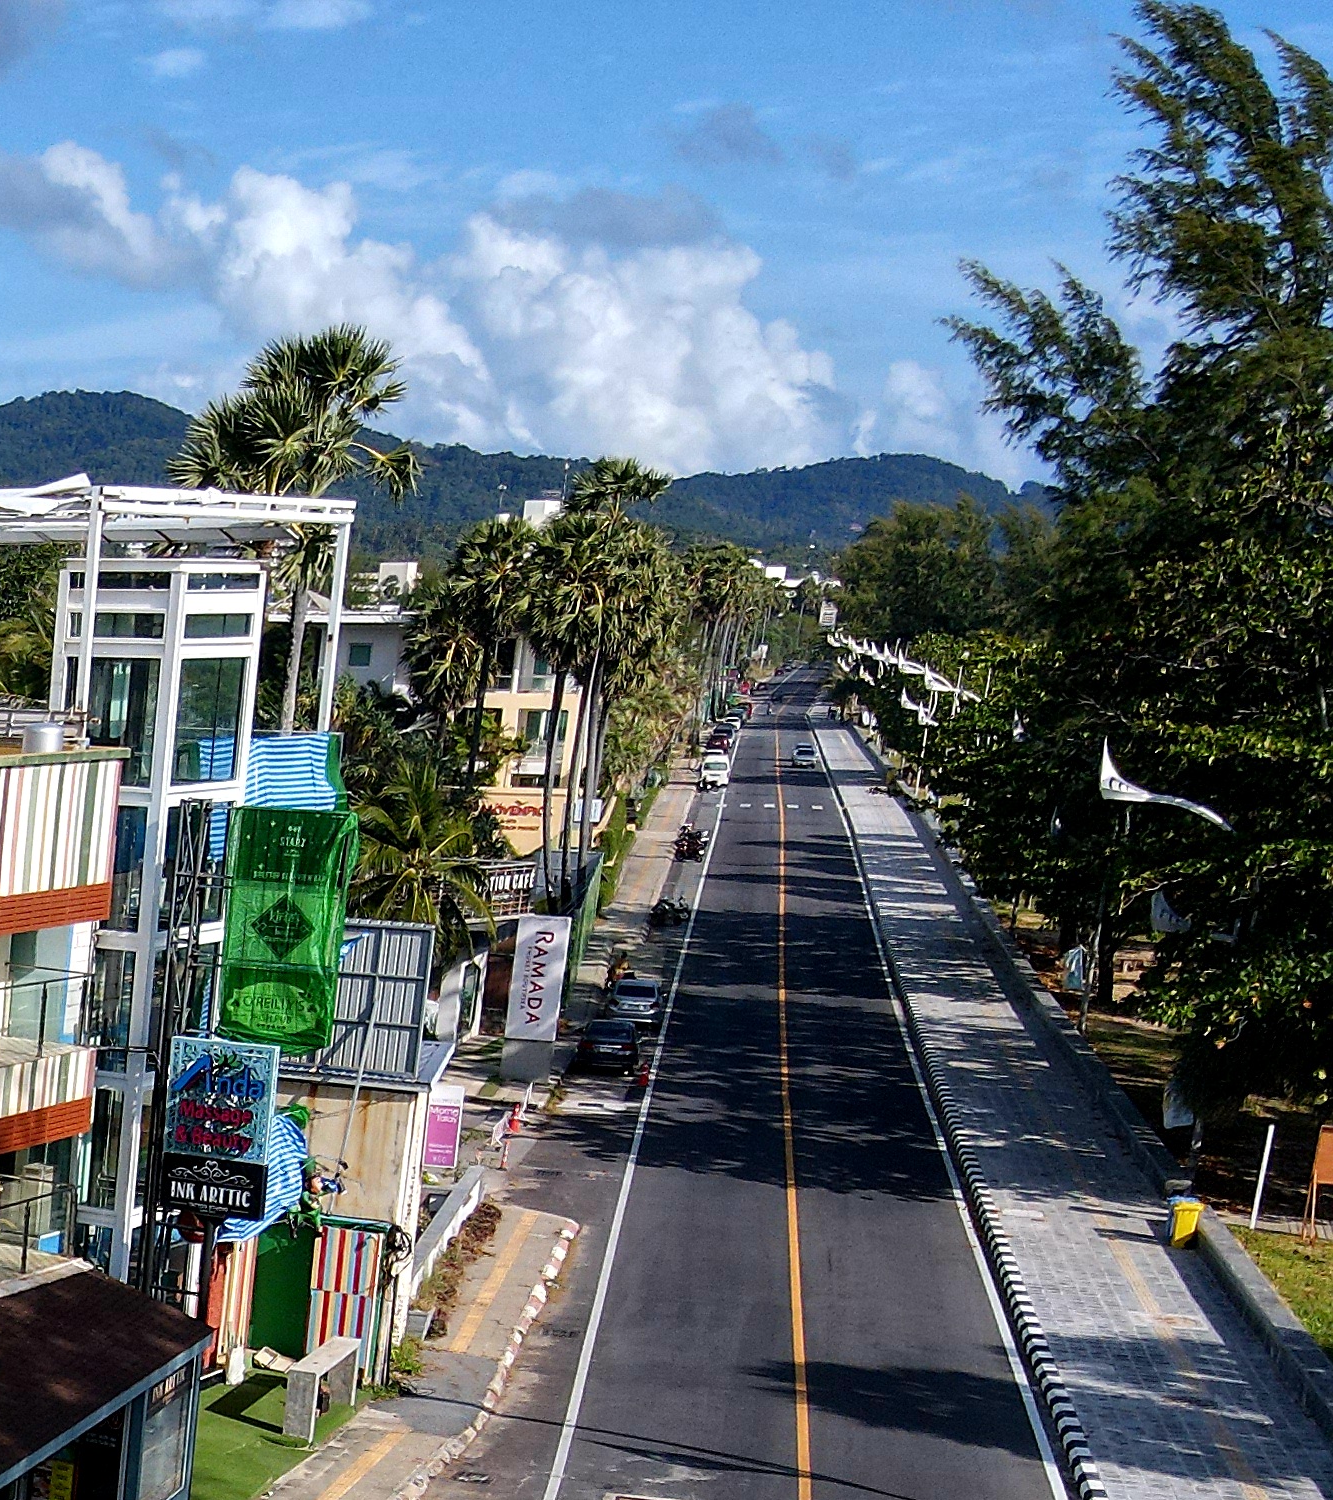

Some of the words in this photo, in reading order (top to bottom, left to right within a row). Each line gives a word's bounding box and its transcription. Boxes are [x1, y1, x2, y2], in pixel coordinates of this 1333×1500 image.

[524, 930, 555, 1025] RAMADA
[172, 1054, 266, 1100] Anda
[178, 1100, 253, 1128] Massage
[174, 1125, 187, 1143] &
[191, 1126, 252, 1154] Beauty
[170, 1181, 196, 1201] INK
